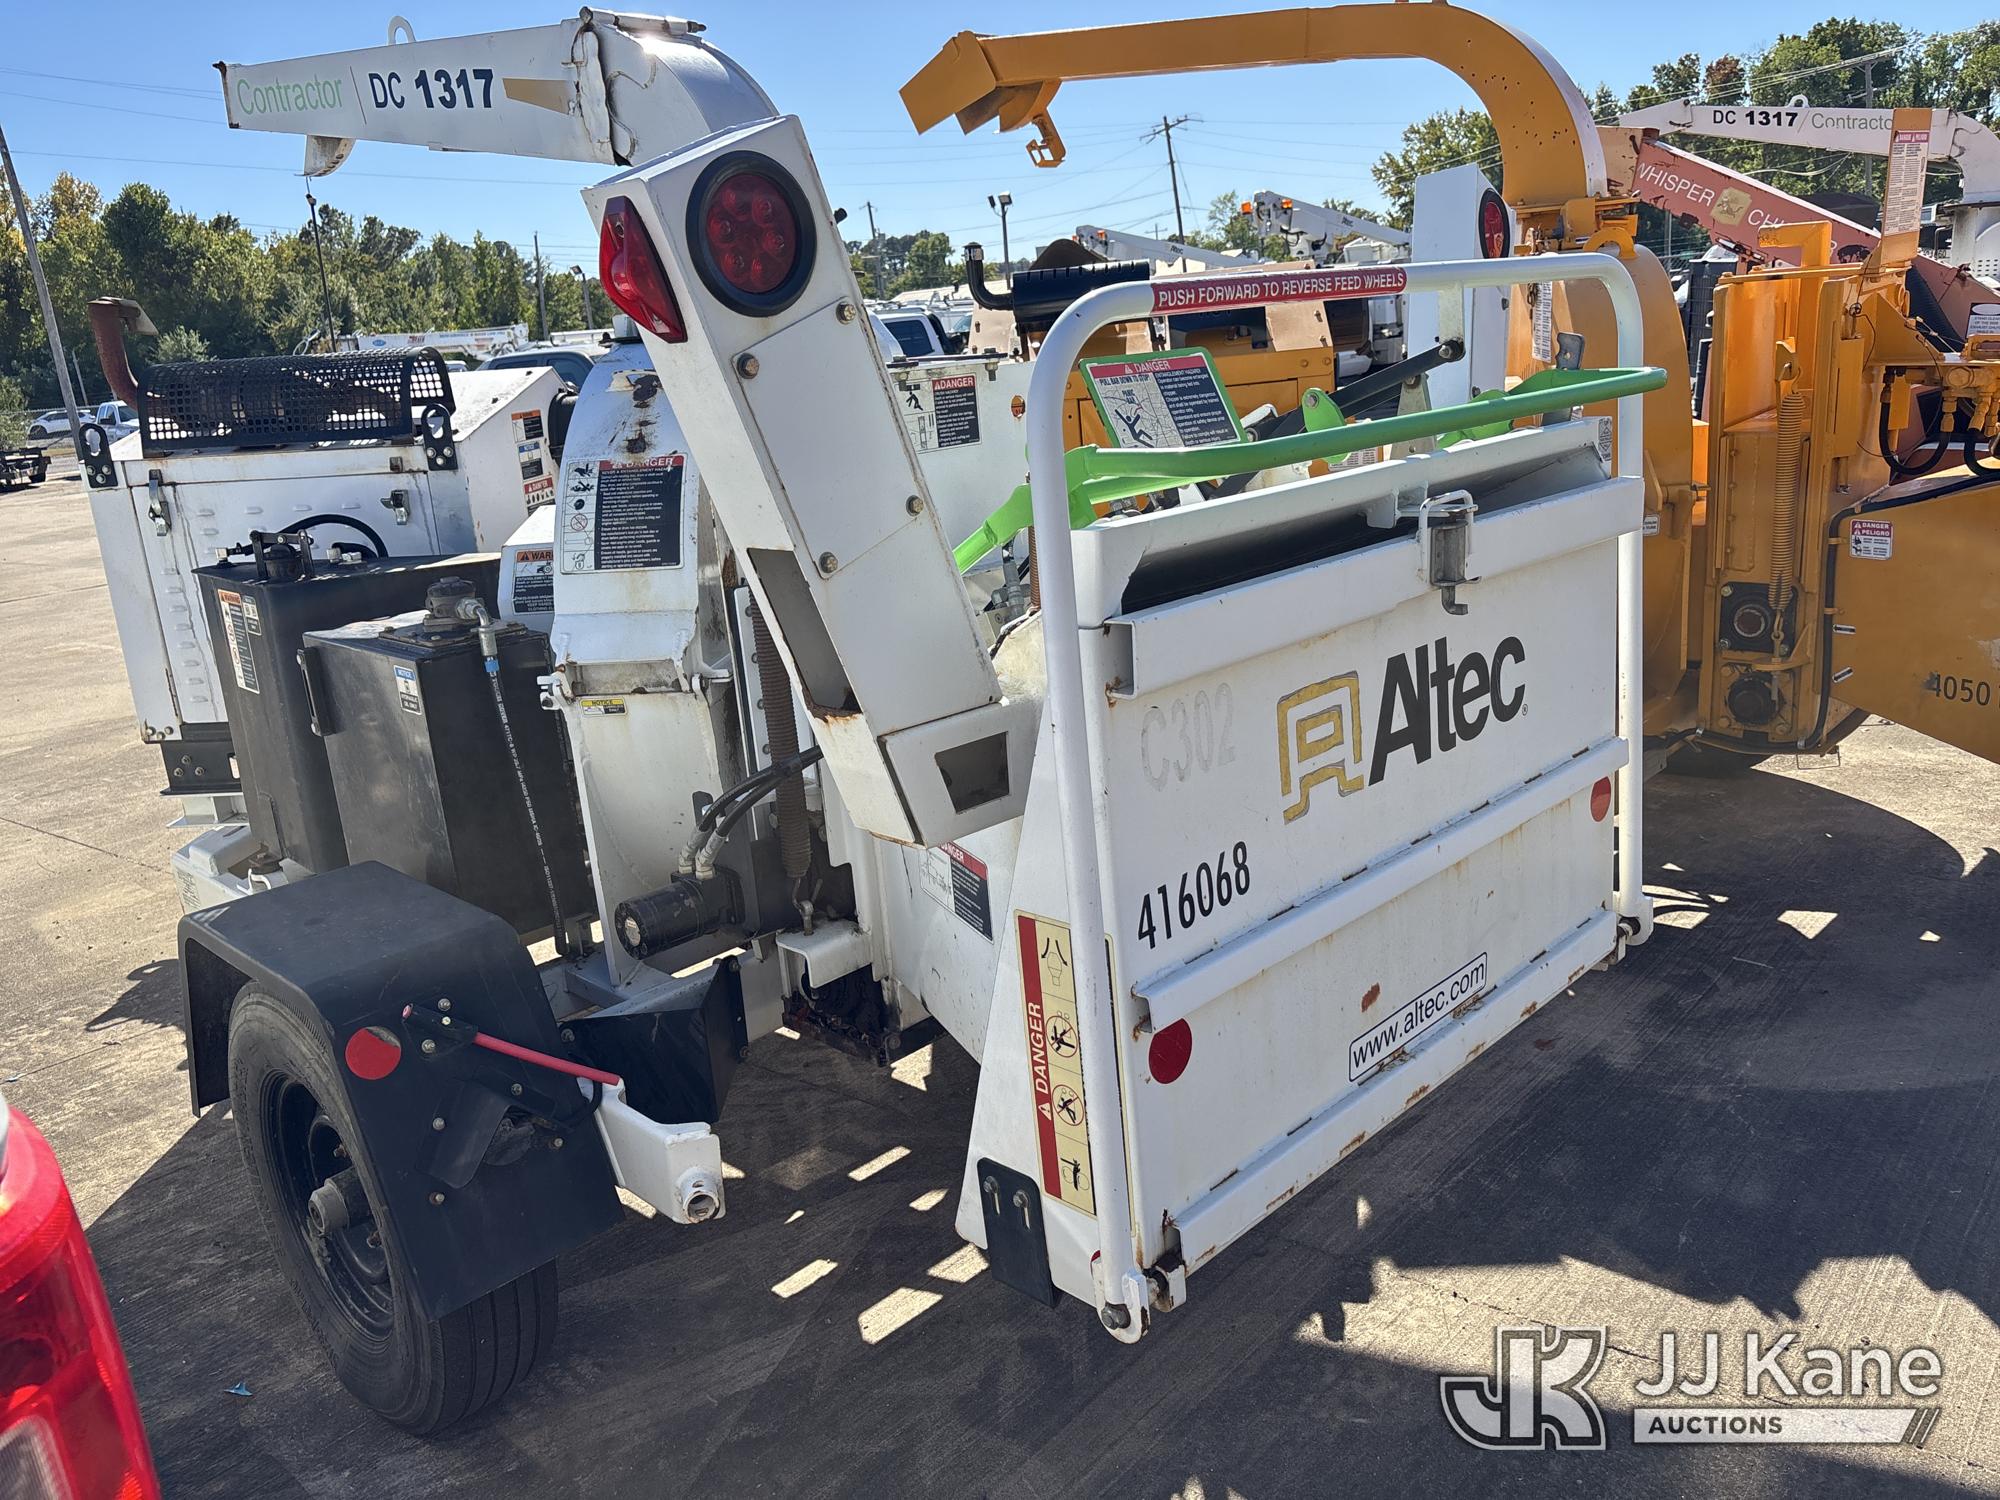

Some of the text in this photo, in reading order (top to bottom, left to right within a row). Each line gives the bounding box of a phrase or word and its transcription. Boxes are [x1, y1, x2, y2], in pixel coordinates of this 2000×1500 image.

[236, 74, 343, 116] Contractor
[368, 69, 494, 109] DC 1317
[1713, 110, 1893, 130] DC 1317 Contracto
[1159, 272, 1404, 307] PUSH FORWARD TO REVERSE FEED WHEELS
[940, 377, 974, 389] DANGER
[1134, 361, 1170, 373] DANGER
[1862, 529, 1890, 537] PELIGRO
[1368, 635, 1526, 787] Altec
[1137, 840, 1251, 950] 416068
[1353, 962, 1484, 1068] www.altec.com
[1028, 1003, 1049, 1095] DANGER
